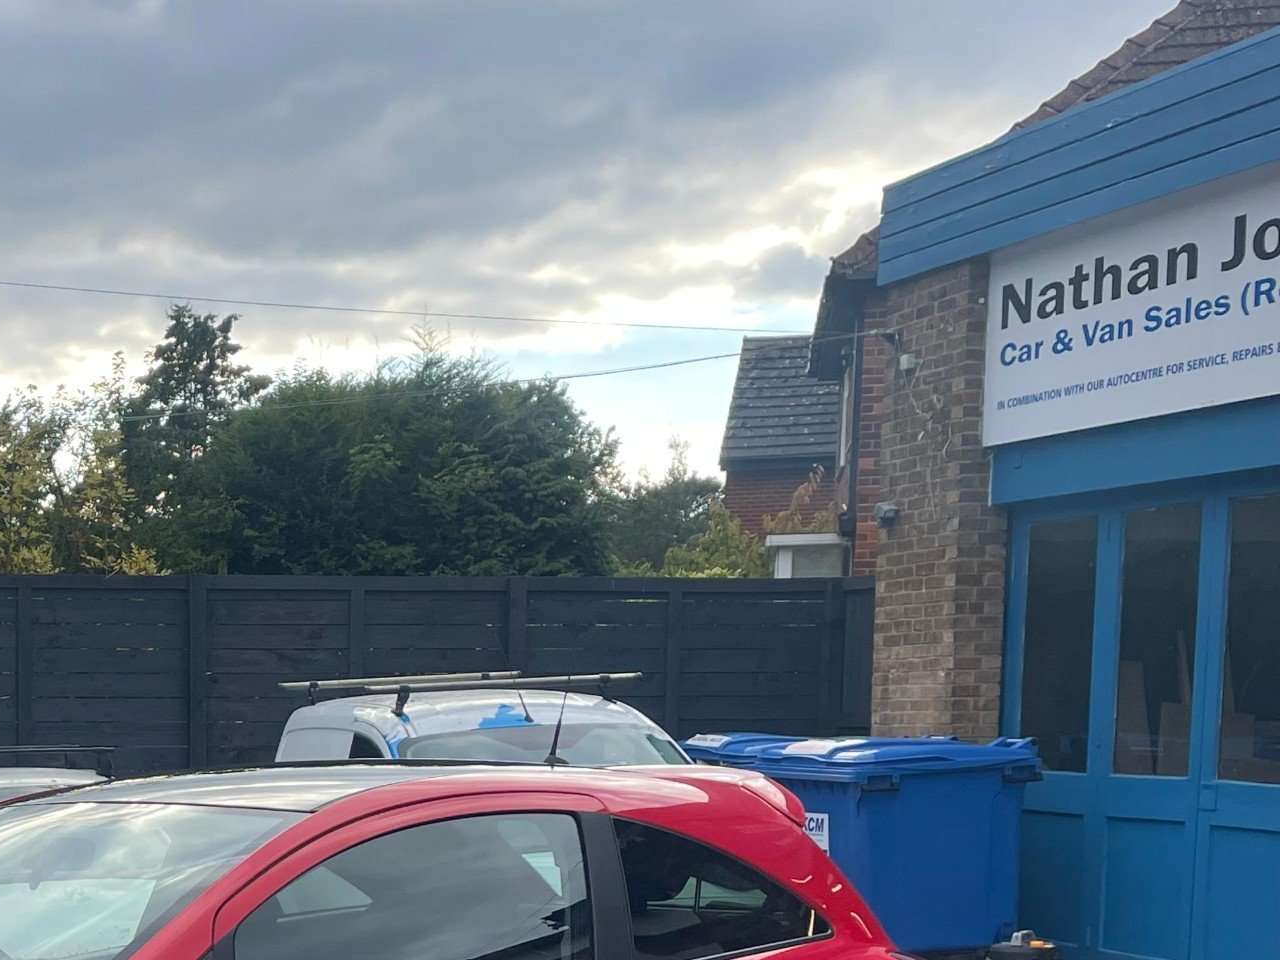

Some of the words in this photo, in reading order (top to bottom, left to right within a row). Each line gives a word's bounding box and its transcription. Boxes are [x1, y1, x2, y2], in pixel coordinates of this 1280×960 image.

[1000, 241, 1199, 330] Nathan
[1000, 340, 1044, 367] Car
[1051, 329, 1073, 355] &
[1082, 318, 1134, 348] Van
[1143, 295, 1231, 333] Sales
[1240, 277, 1280, 316] (R
[996, 401, 1006, 411] IN
[1006, 388, 1062, 409] COMBINATION
[1063, 383, 1085, 397] WITH
[1087, 379, 1105, 392] OUR
[1106, 365, 1163, 388] AUTOCENTRE
[1165, 362, 1185, 376] FOR
[1186, 353, 1229, 372] SERVICE,
[1231, 343, 1274, 362] REPAIRS
